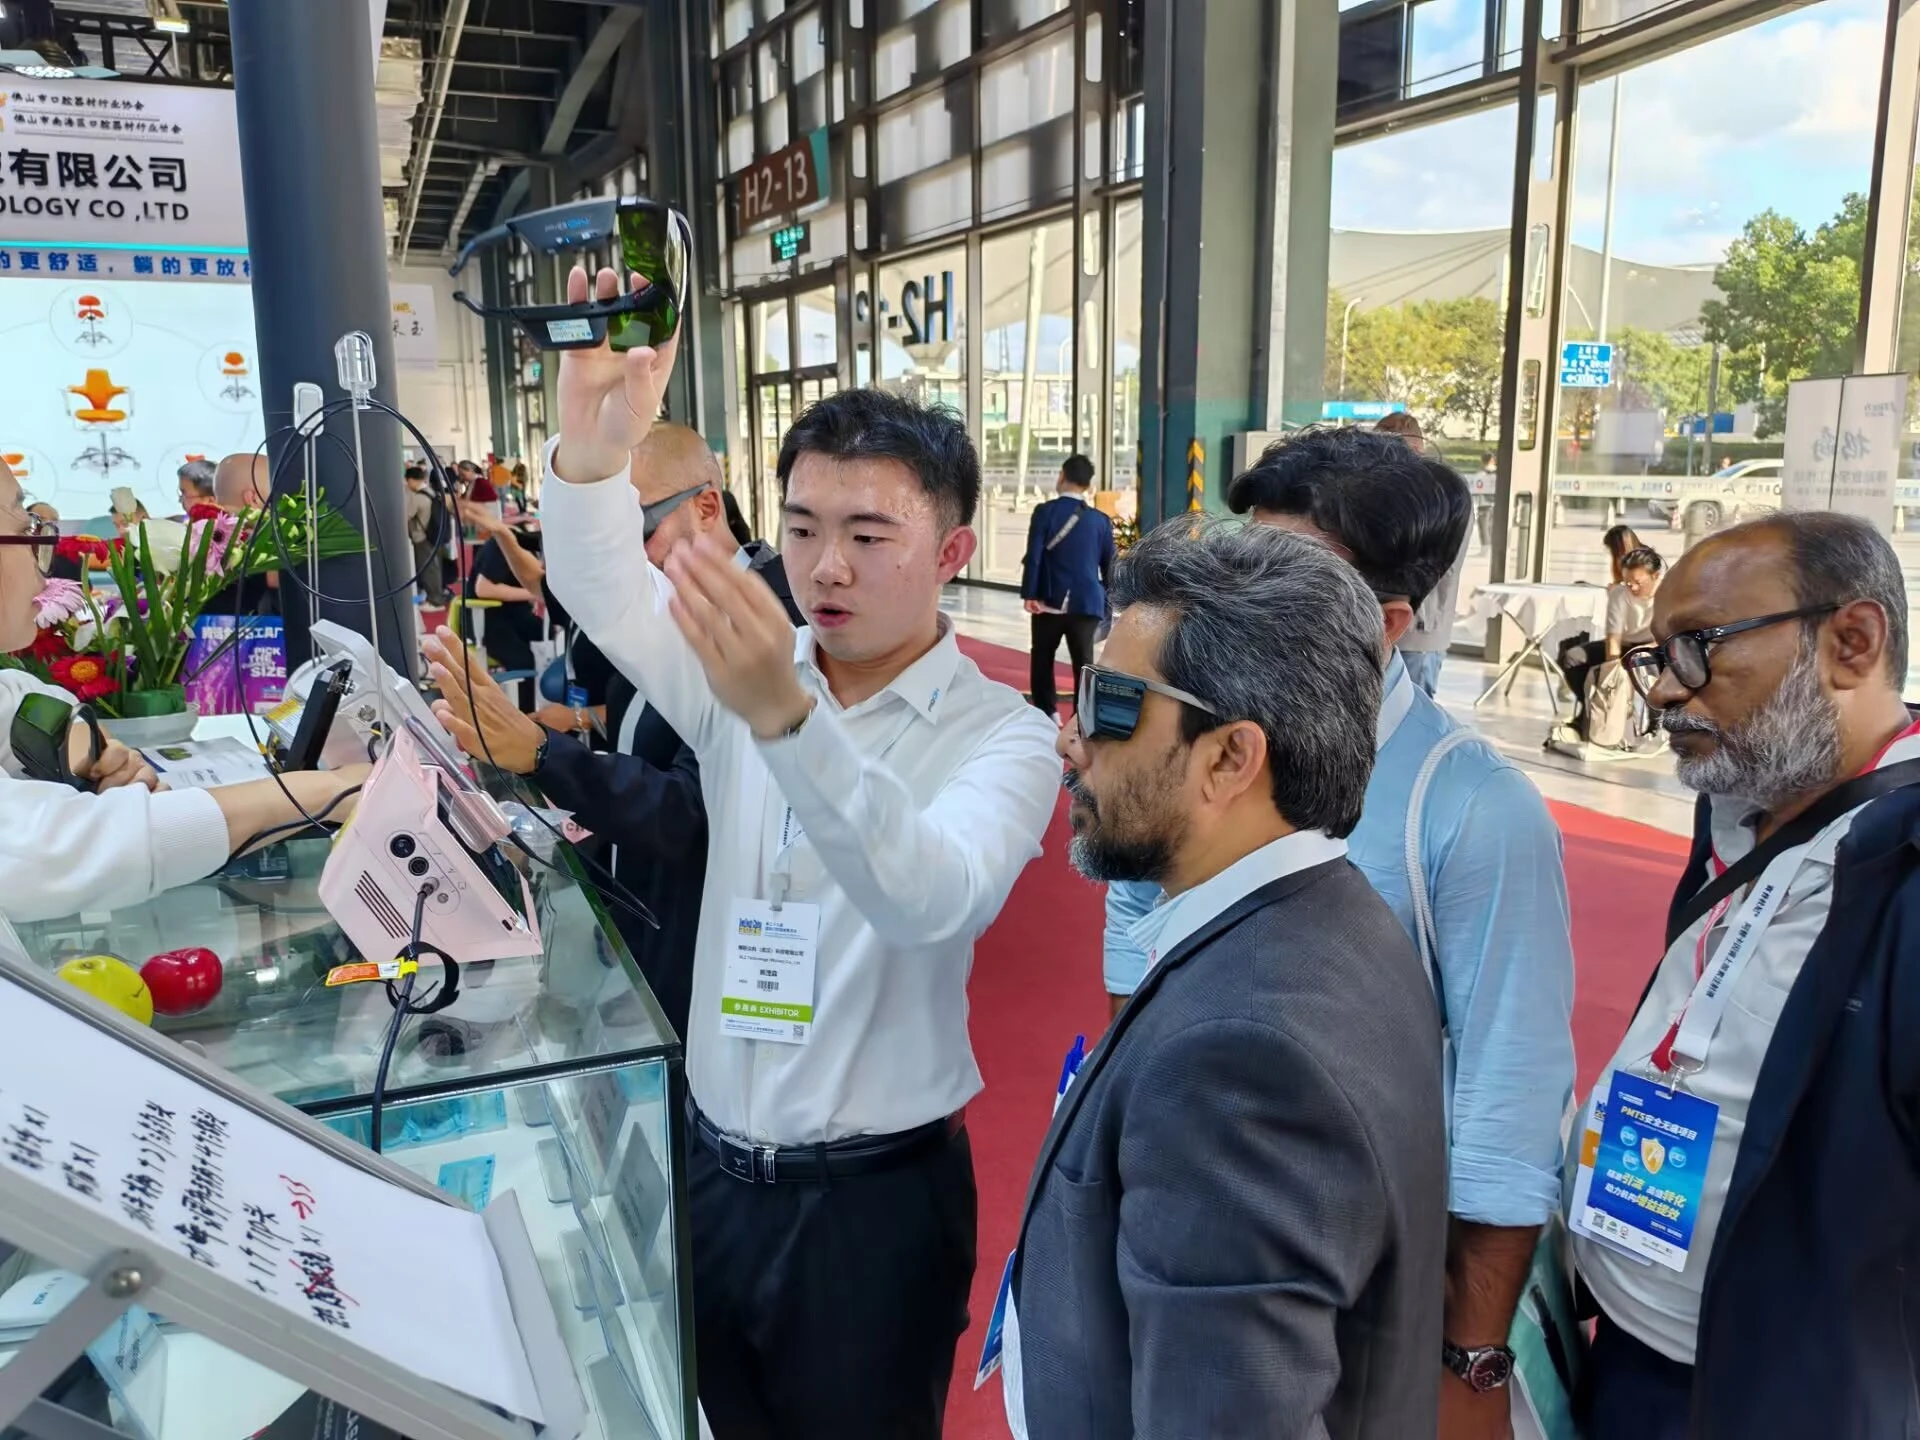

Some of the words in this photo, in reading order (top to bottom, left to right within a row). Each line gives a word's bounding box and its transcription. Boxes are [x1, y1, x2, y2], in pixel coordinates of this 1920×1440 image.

[0, 148, 187, 193] 有限公司
[745, 150, 808, 219] H2-13
[89, 200, 125, 218] CO
[250, 666, 287, 678] SIZE
[759, 1006, 800, 1017] EXHIBITOR
